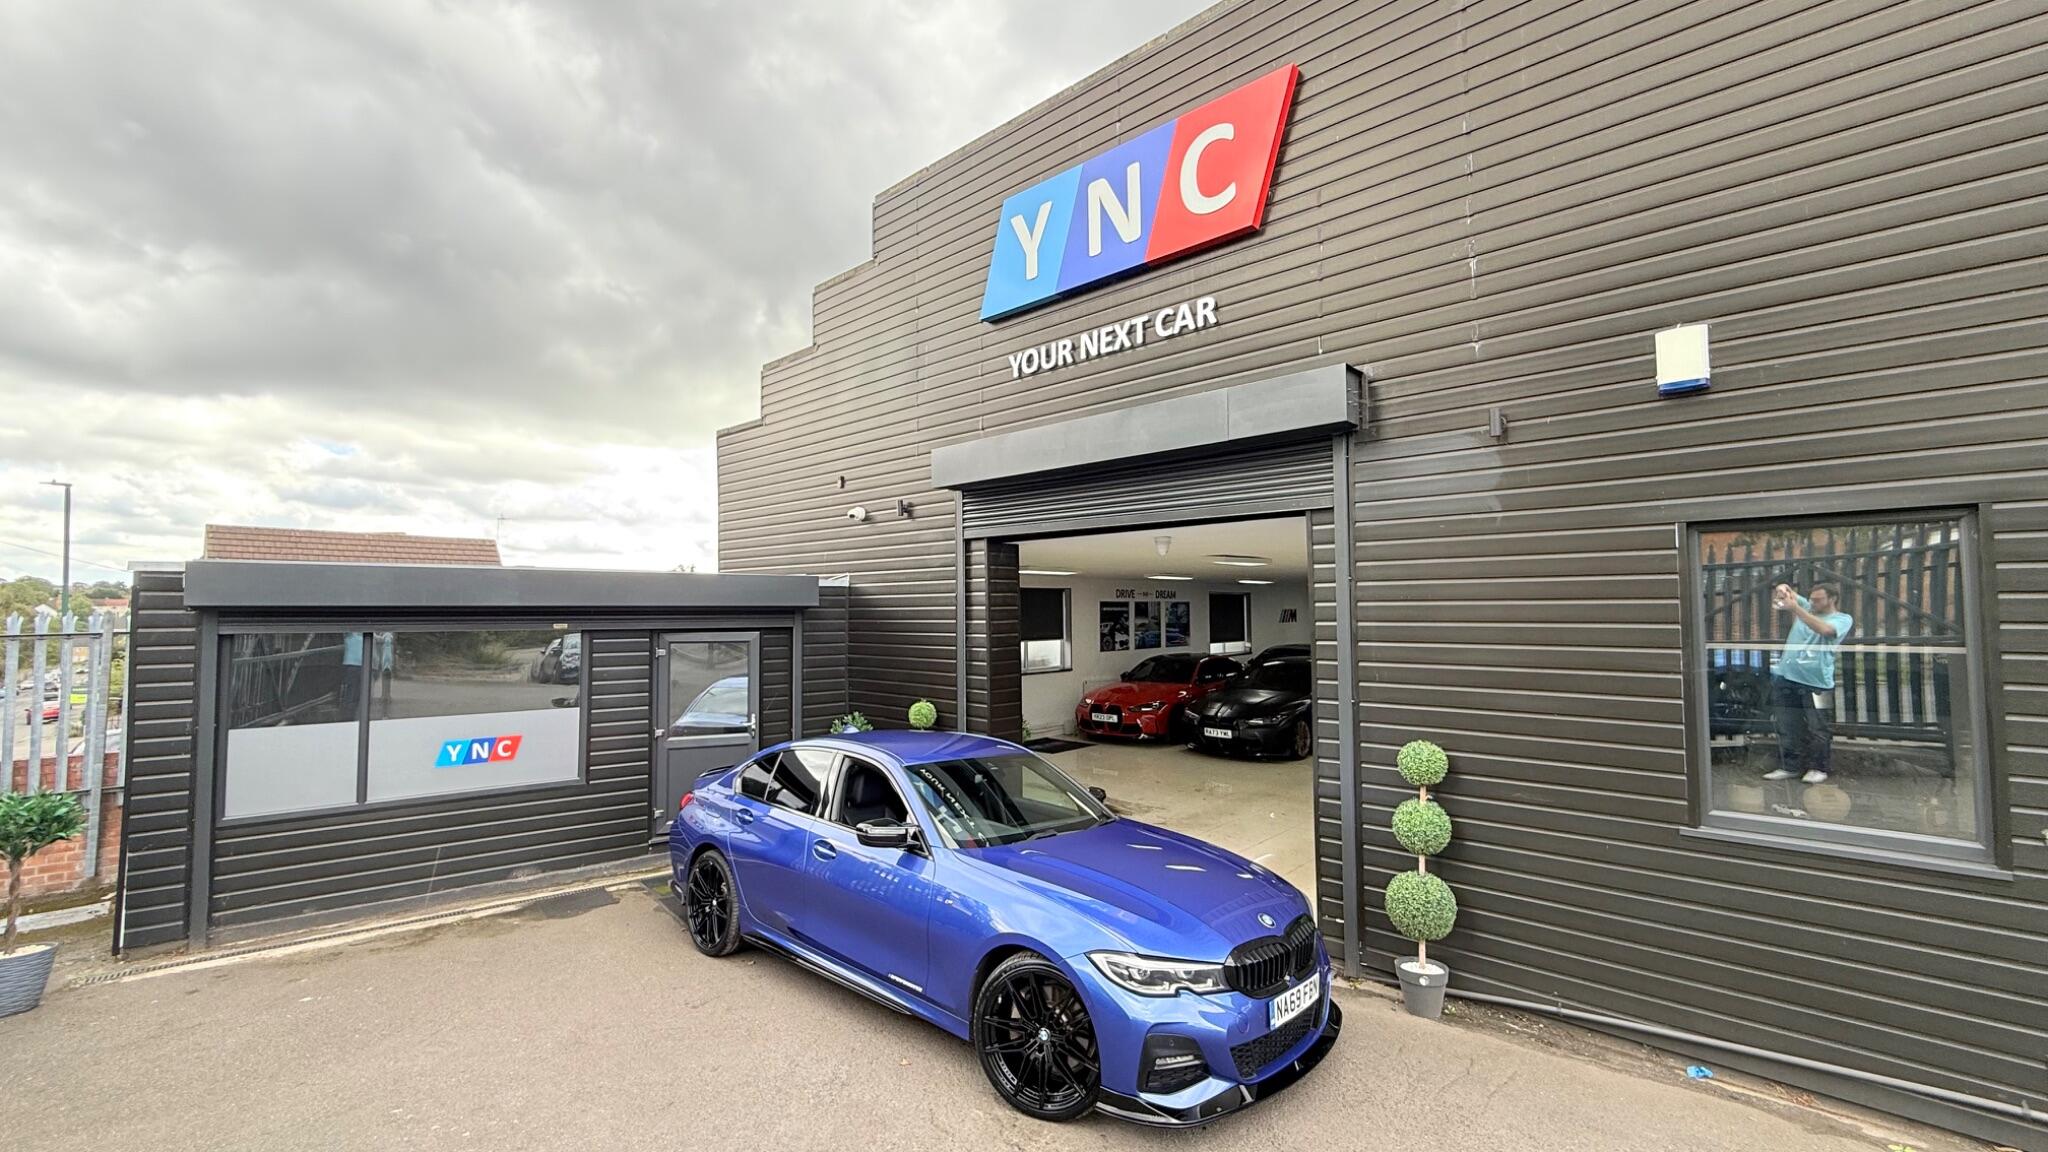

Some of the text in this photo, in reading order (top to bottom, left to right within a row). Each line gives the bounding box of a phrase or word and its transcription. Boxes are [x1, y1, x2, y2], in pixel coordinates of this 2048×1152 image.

[1010, 122, 1236, 281] YNC
[1008, 296, 1218, 379] YOUR NEXT CAR
[1115, 588, 1136, 599] DRIVE
[446, 740, 512, 762] YNC
[1276, 988, 1301, 1021] NA69
